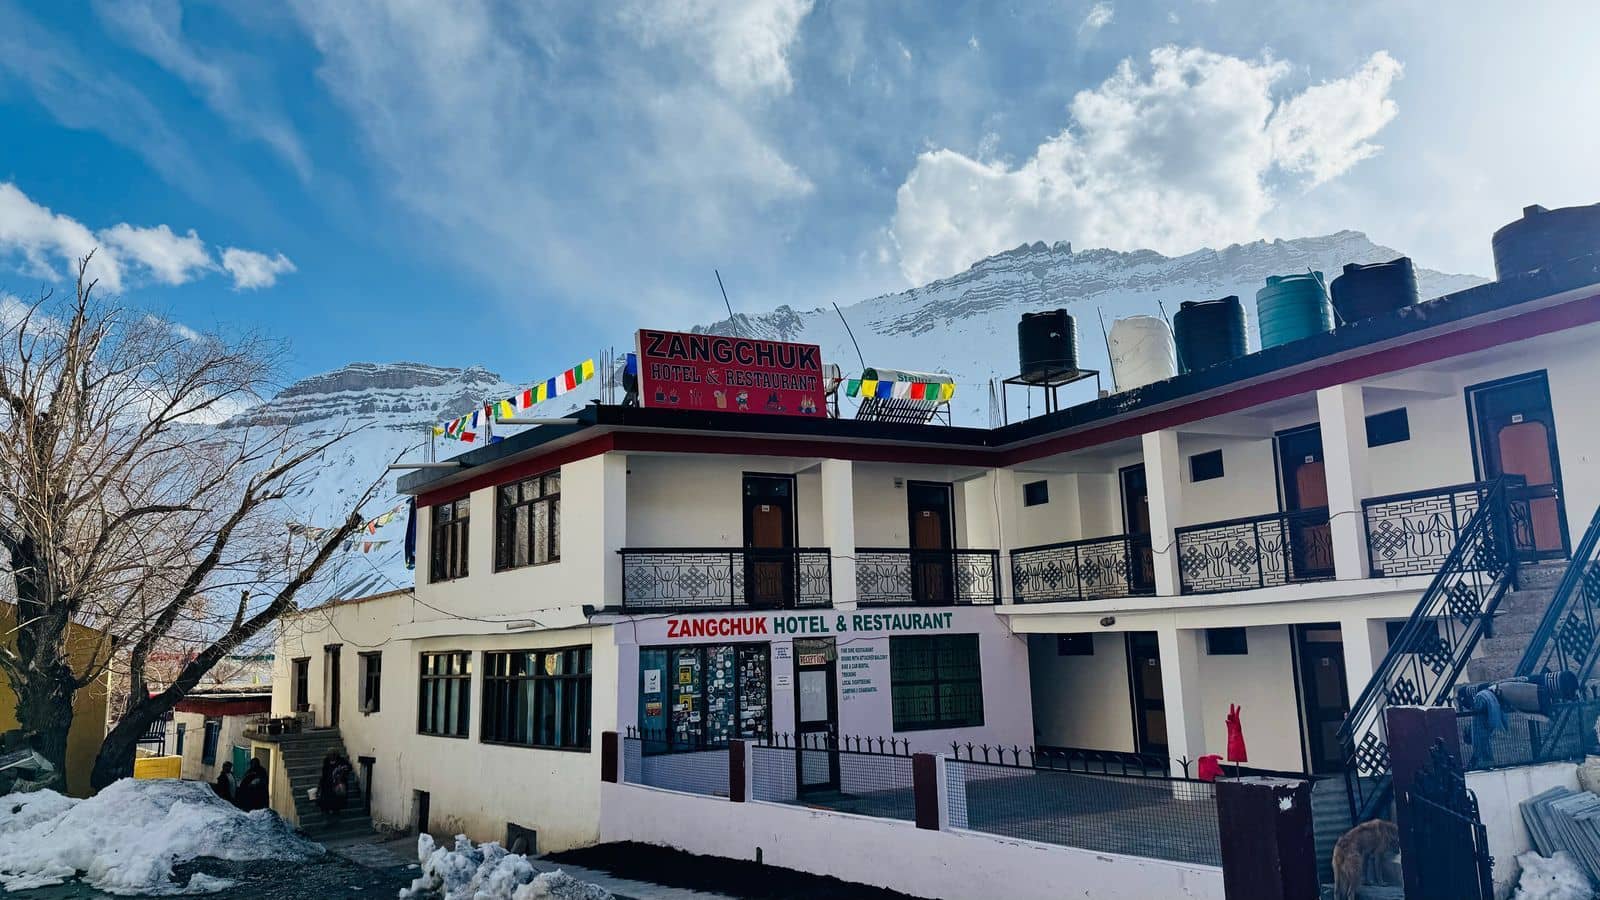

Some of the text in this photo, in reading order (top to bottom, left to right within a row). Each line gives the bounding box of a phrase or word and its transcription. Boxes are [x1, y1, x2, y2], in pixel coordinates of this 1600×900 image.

[646, 332, 820, 371] ZANGCHUK
[651, 364, 817, 391] HOTEL & RESTAURANT
[667, 612, 953, 638] ZANGCHUK HOTEL & RESTAURANT
[800, 655, 827, 665] RECEPTION
